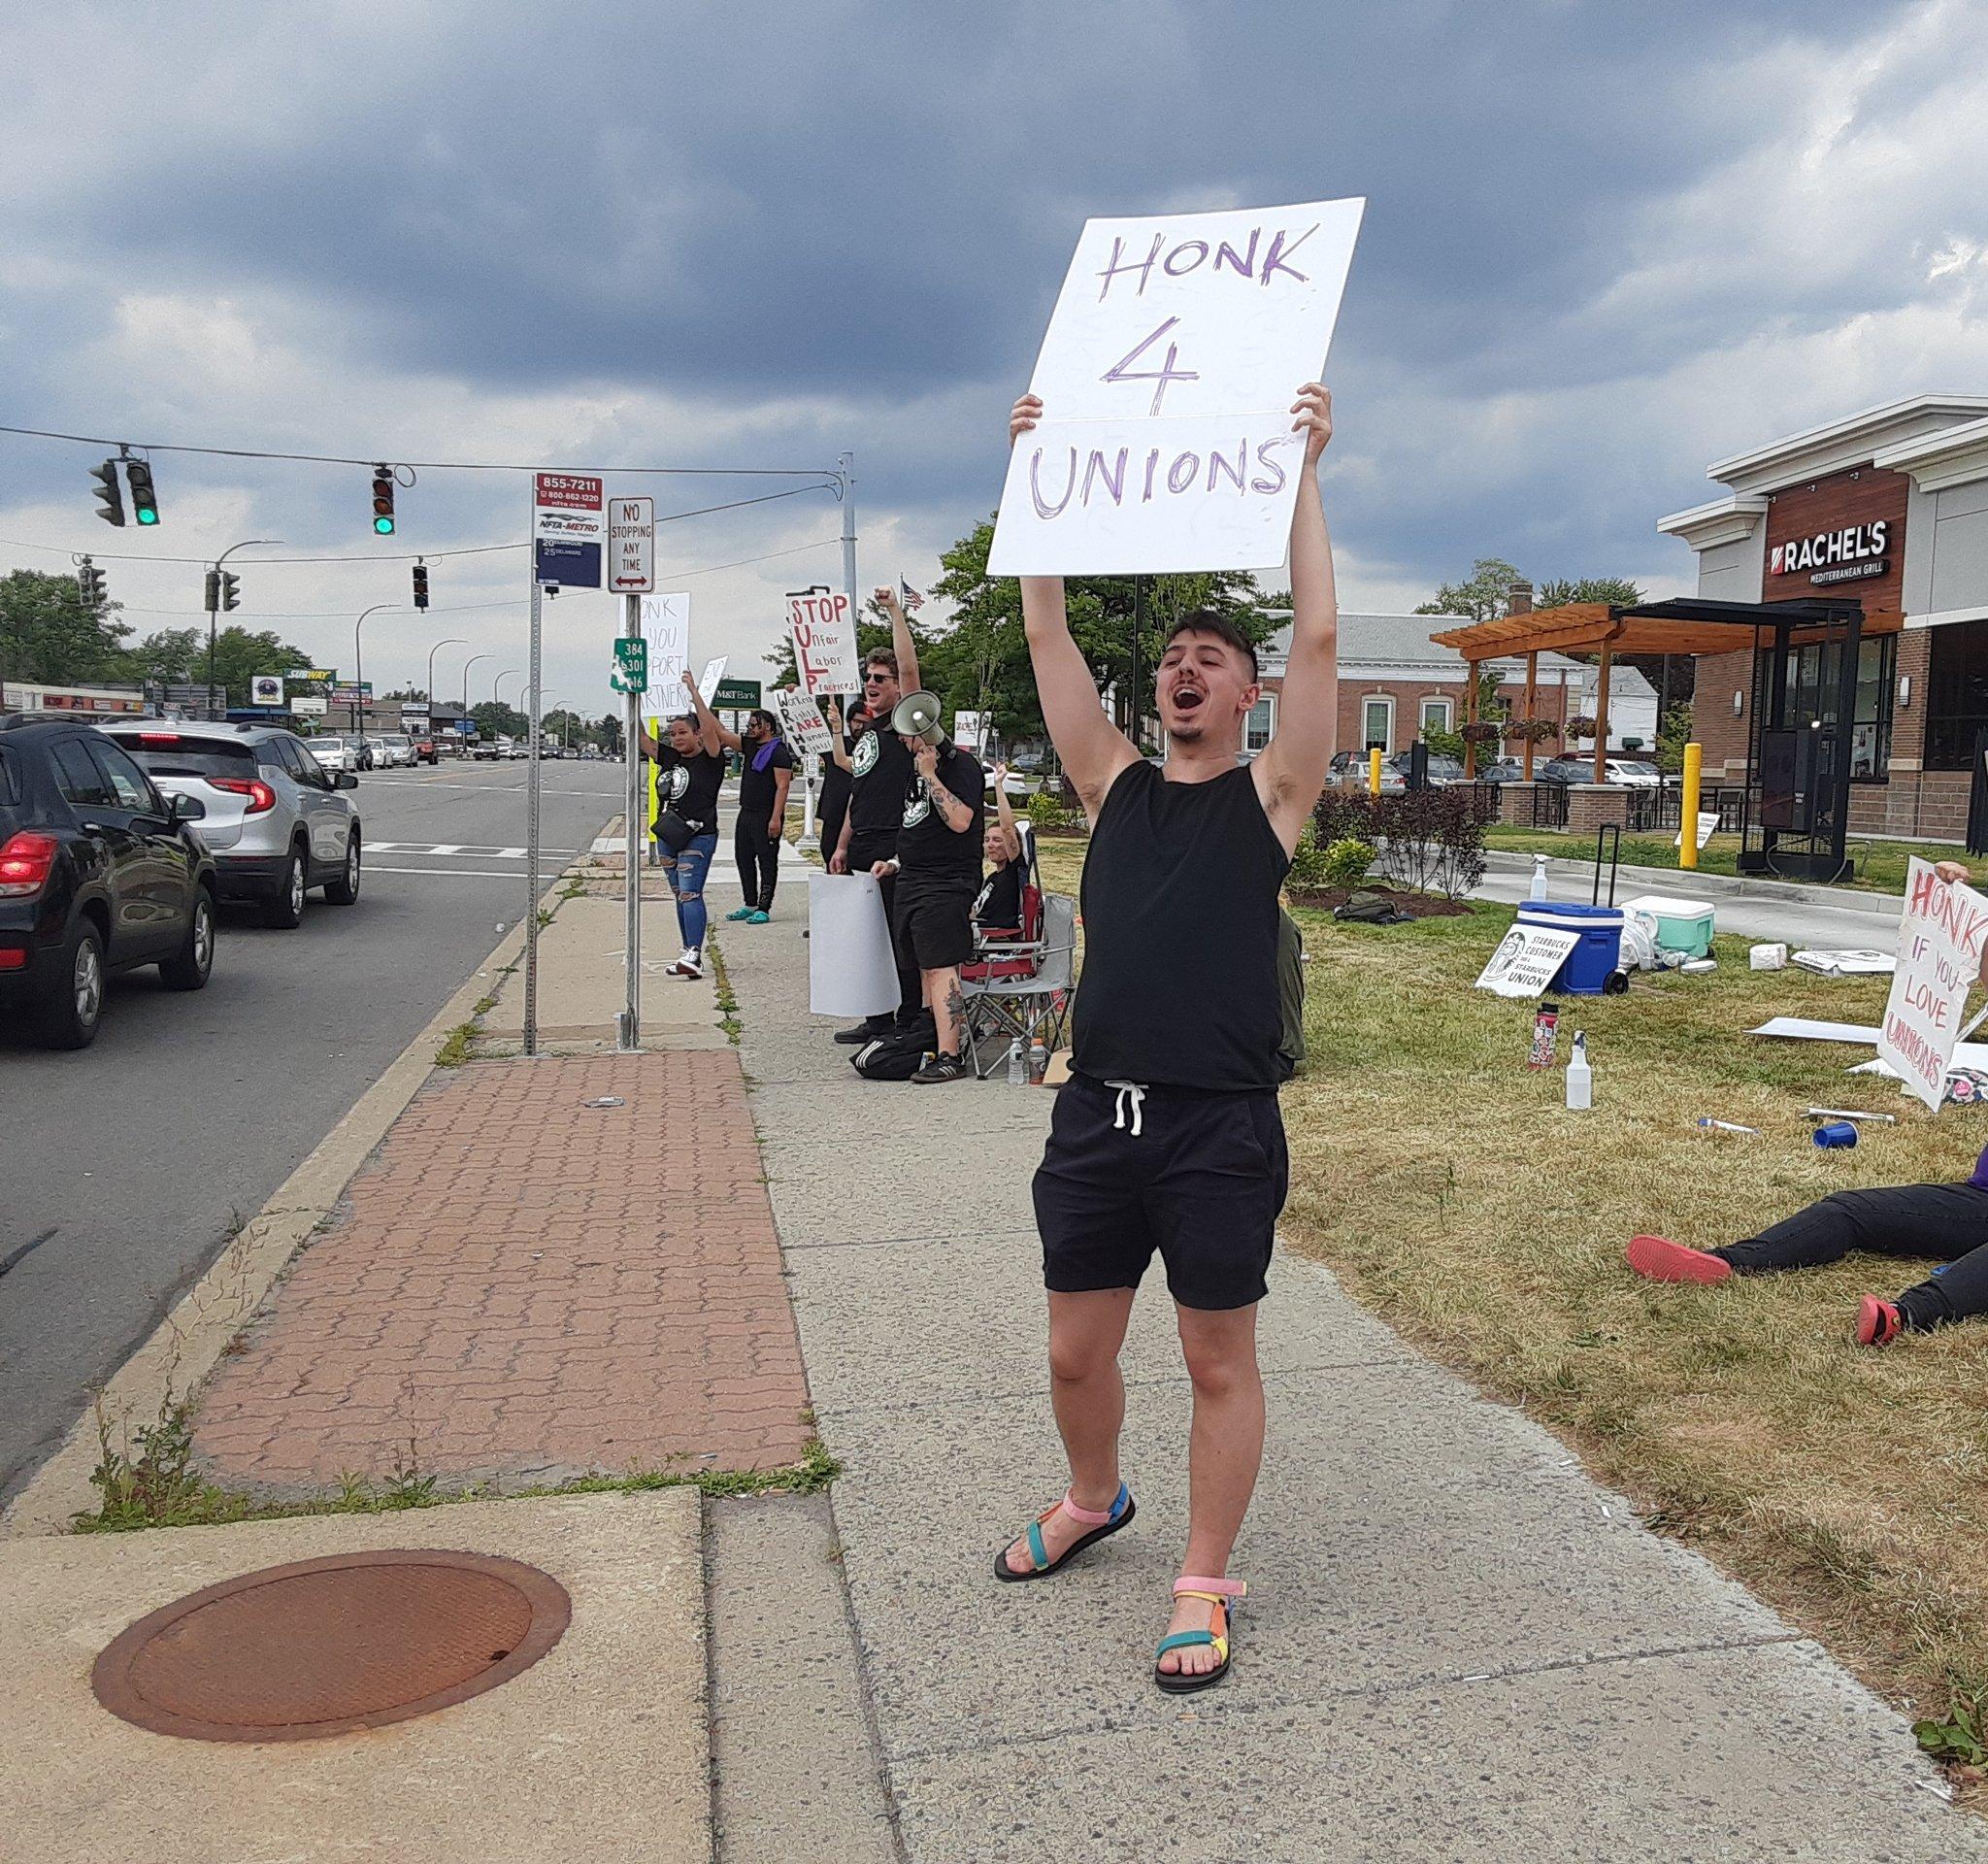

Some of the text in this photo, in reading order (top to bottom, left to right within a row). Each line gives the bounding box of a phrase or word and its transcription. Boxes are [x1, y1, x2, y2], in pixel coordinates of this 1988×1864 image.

[1095, 222, 1321, 304] HONK
[1099, 316, 1200, 416] 4
[543, 477, 597, 491] 855-7211
[1030, 436, 1290, 519] UNIONS
[623, 504, 640, 521] NO
[539, 520, 599, 532] NFTA-METRO
[612, 525, 651, 539] STOPPING
[544, 548, 556, 556] 25
[623, 543, 641, 554] ANY
[1784, 520, 1886, 572] RACHEL'S
[622, 558, 641, 571] TIME
[1809, 562, 1883, 583] MEDITERRANEAN GRILL
[642, 598, 678, 619] ONK
[791, 595, 847, 624] STOP
[649, 626, 678, 650] YOU
[794, 624, 840, 648] Unfair
[624, 643, 643, 655] 384
[647, 655, 684, 677] PORT
[801, 649, 843, 674] Labor
[287, 669, 332, 680] SUBWAY
[716, 689, 756, 699] M&T Bank
[796, 715, 823, 732] ARE
[1908, 868, 1988, 959] HONK
[1531, 936, 1571, 950] STARBUCKS
[1525, 947, 1564, 960] CUSTOMER
[1514, 964, 1552, 976] STARBUCKS
[1912, 935, 1961, 992] IF YOU
[1508, 972, 1546, 987] UNION
[1905, 975, 1947, 1029] LOVE
[1886, 1012, 1943, 1091] UNIONS
